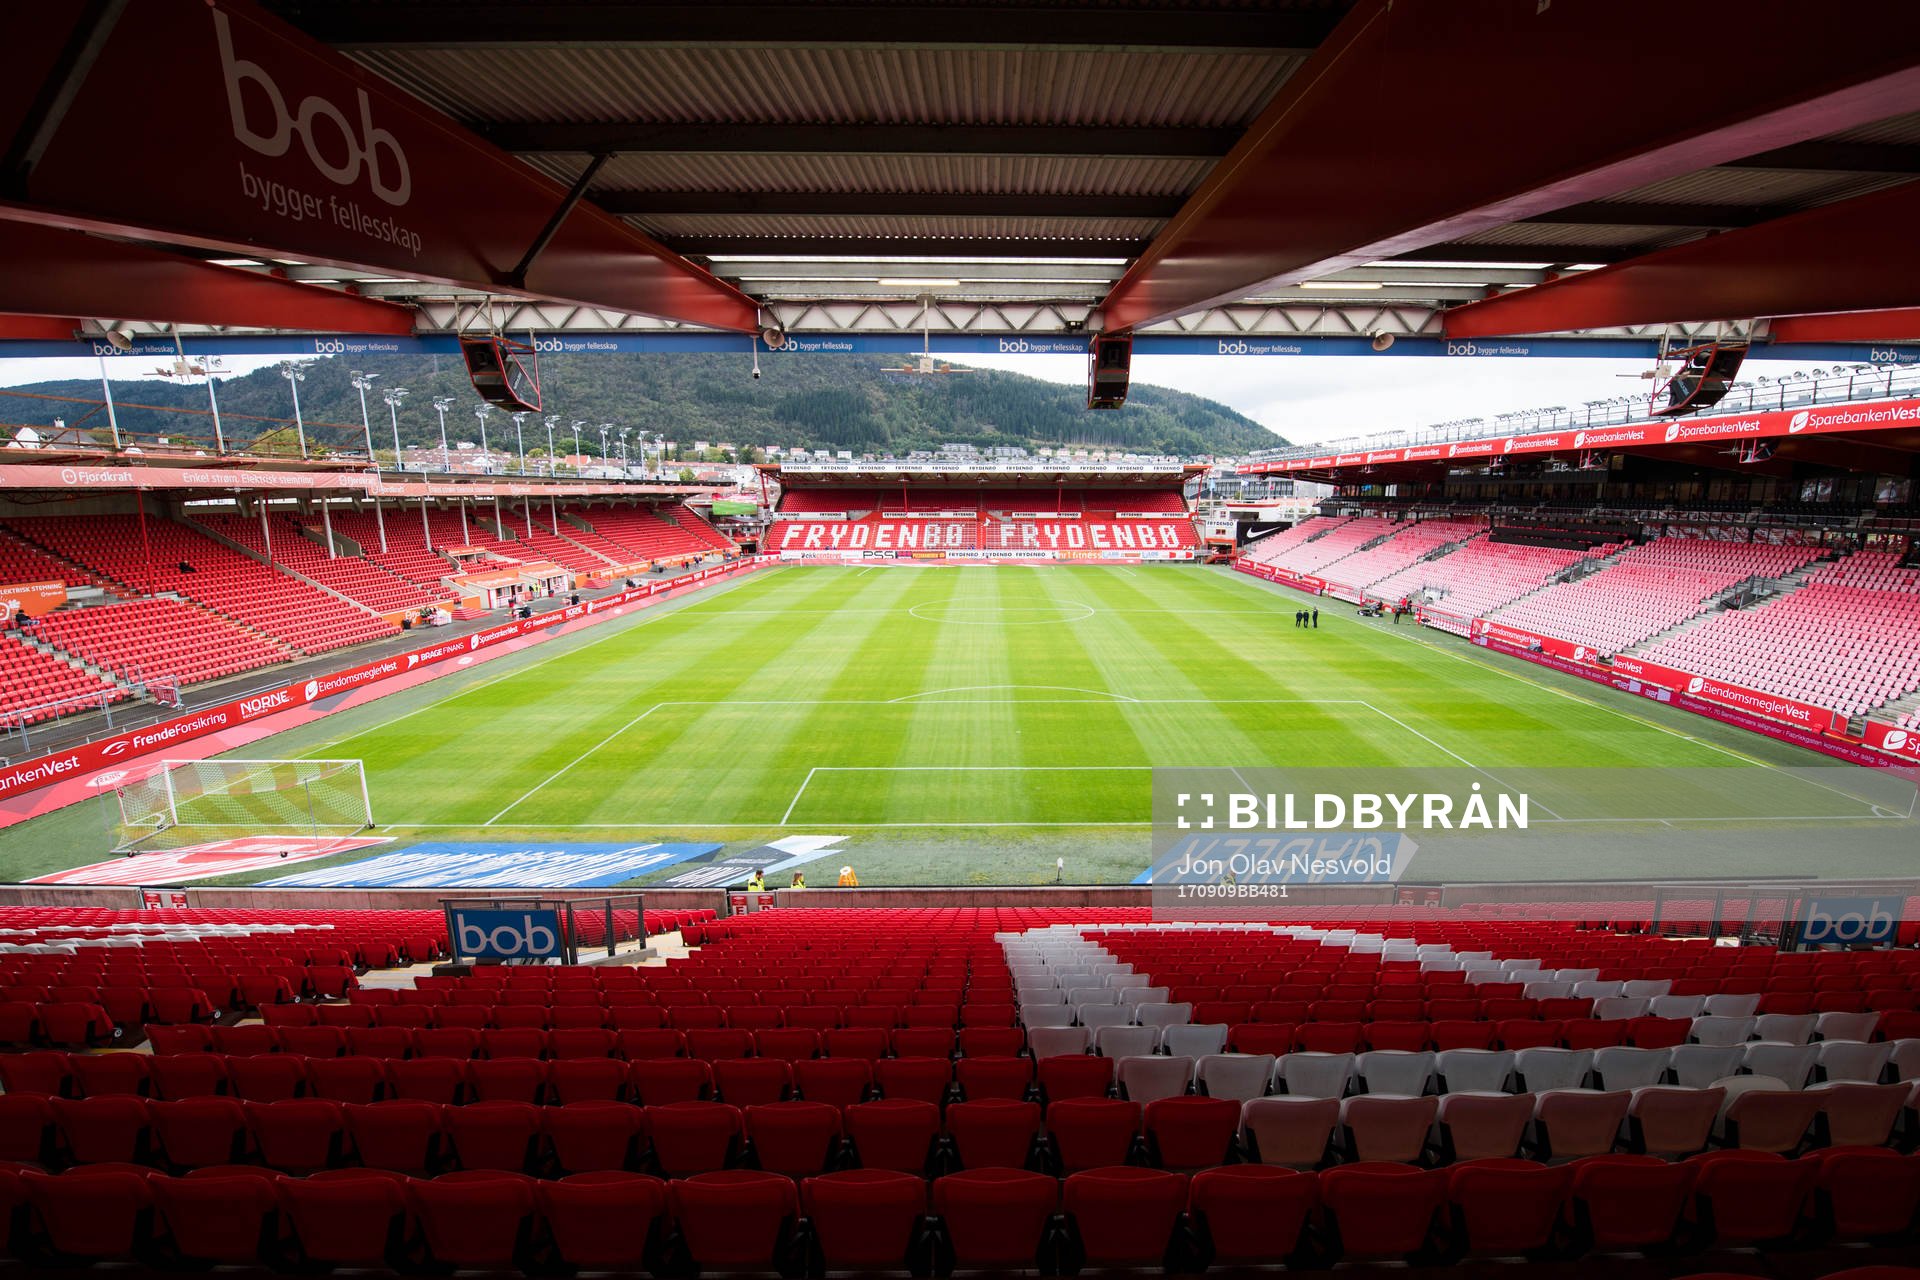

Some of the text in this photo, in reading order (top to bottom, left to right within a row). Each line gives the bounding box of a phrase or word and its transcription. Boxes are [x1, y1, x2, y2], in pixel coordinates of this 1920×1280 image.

[212, 7, 411, 206] bob
[240, 160, 421, 257] bygger fellesskap
[144, 345, 174, 354] fellesskap
[315, 338, 398, 352] bob bygger fellesskap
[534, 338, 618, 351] bob bygger fellesskap
[799, 341, 821, 351] bygger
[822, 341, 852, 350] fellesskap
[999, 338, 1083, 352] bob bygger fellesskap
[1218, 340, 1301, 354] bob bygger fellesskap
[1447, 341, 1528, 355] bob bygger fellesskap
[1870, 348, 1897, 361] bob
[1809, 406, 1920, 428] SparebankenVest
[1680, 420, 1760, 438] SparebankenVest
[1584, 431, 1645, 445] SparebankenVest
[79, 471, 134, 485] Fjordkraft
[183, 472, 209, 483] Enkel
[318, 661, 398, 692] EiendomsmeglerVest
[240, 690, 290, 716] NORNE
[1703, 682, 1810, 721] EiendomsmeglerVest
[133, 711, 227, 749] FrendeForsikring
[0, 755, 80, 791] ankenVest
[1803, 901, 1893, 940] bob
[457, 913, 555, 955] bob
